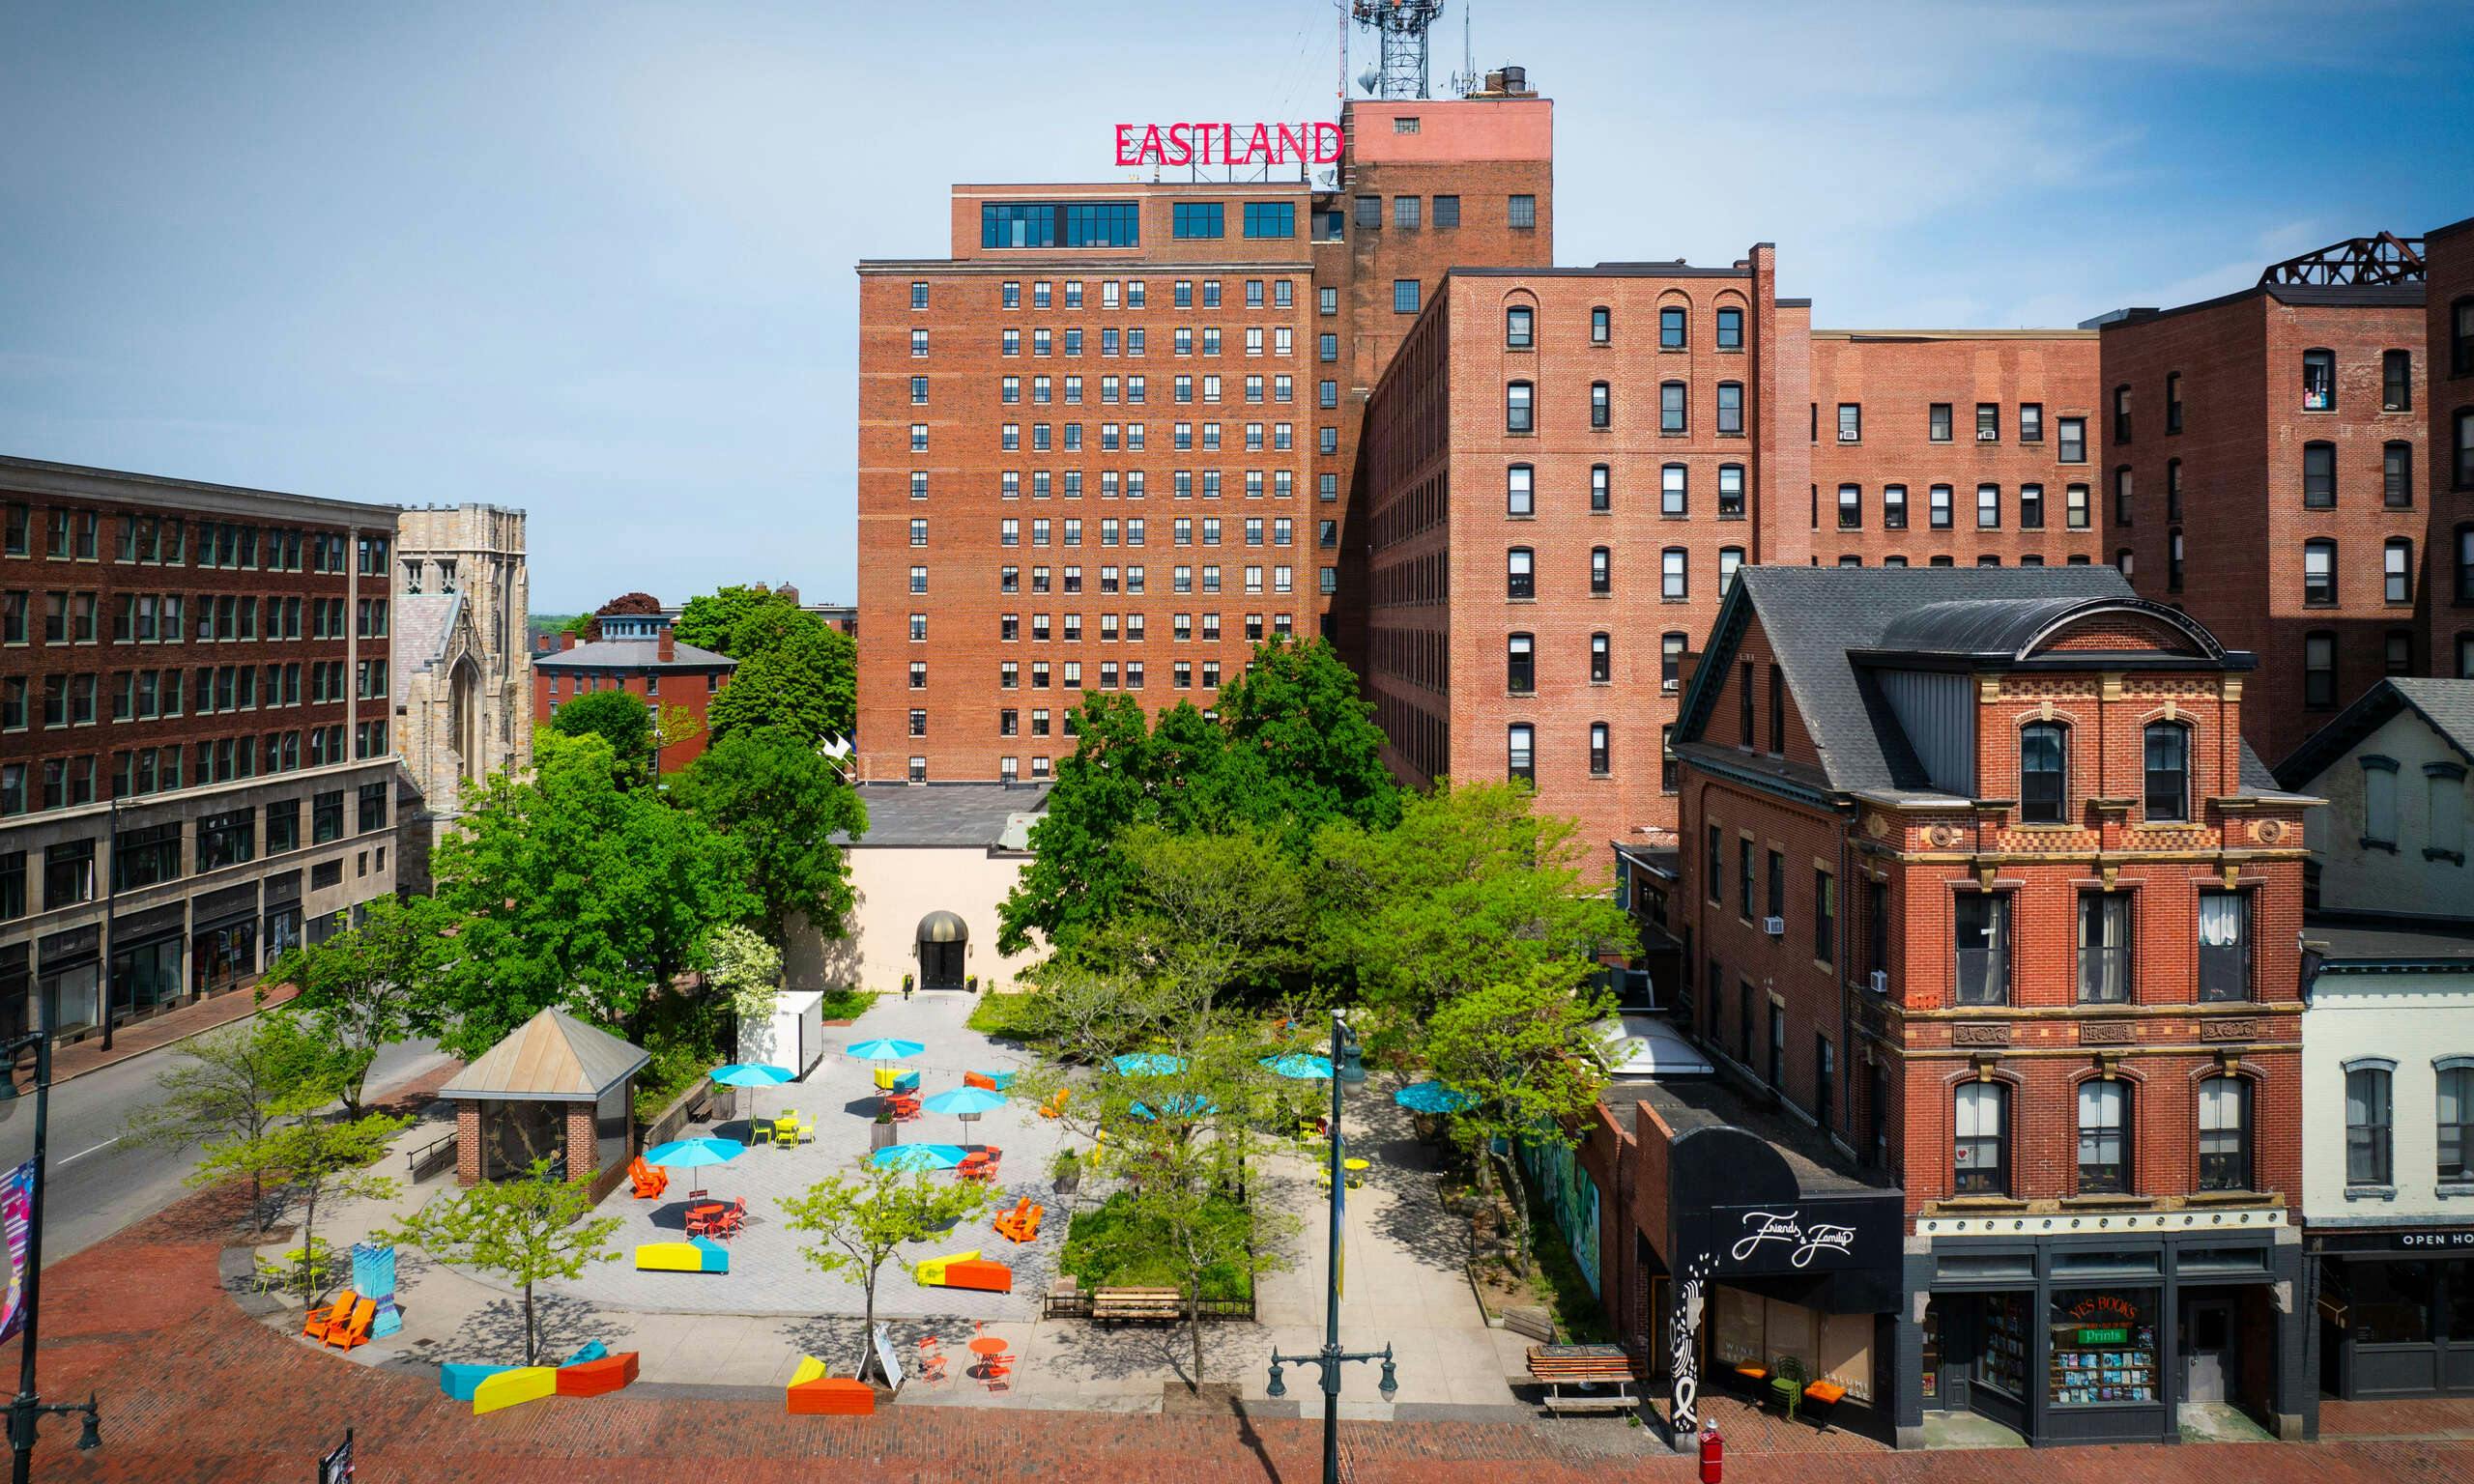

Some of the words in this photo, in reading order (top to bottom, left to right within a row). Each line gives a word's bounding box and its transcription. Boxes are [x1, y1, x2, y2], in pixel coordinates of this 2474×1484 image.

[1114, 122, 1345, 166] EASTLAND
[1732, 1210, 1801, 1260] Friends
[1791, 1224, 1856, 1268] Family
[1799, 1236, 1807, 1244] &
[2402, 1235, 2445, 1244] OPEN
[2069, 1298, 2095, 1320] YES
[2097, 1297, 2137, 1319] BOOKS
[2086, 1329, 2120, 1343] Prints
